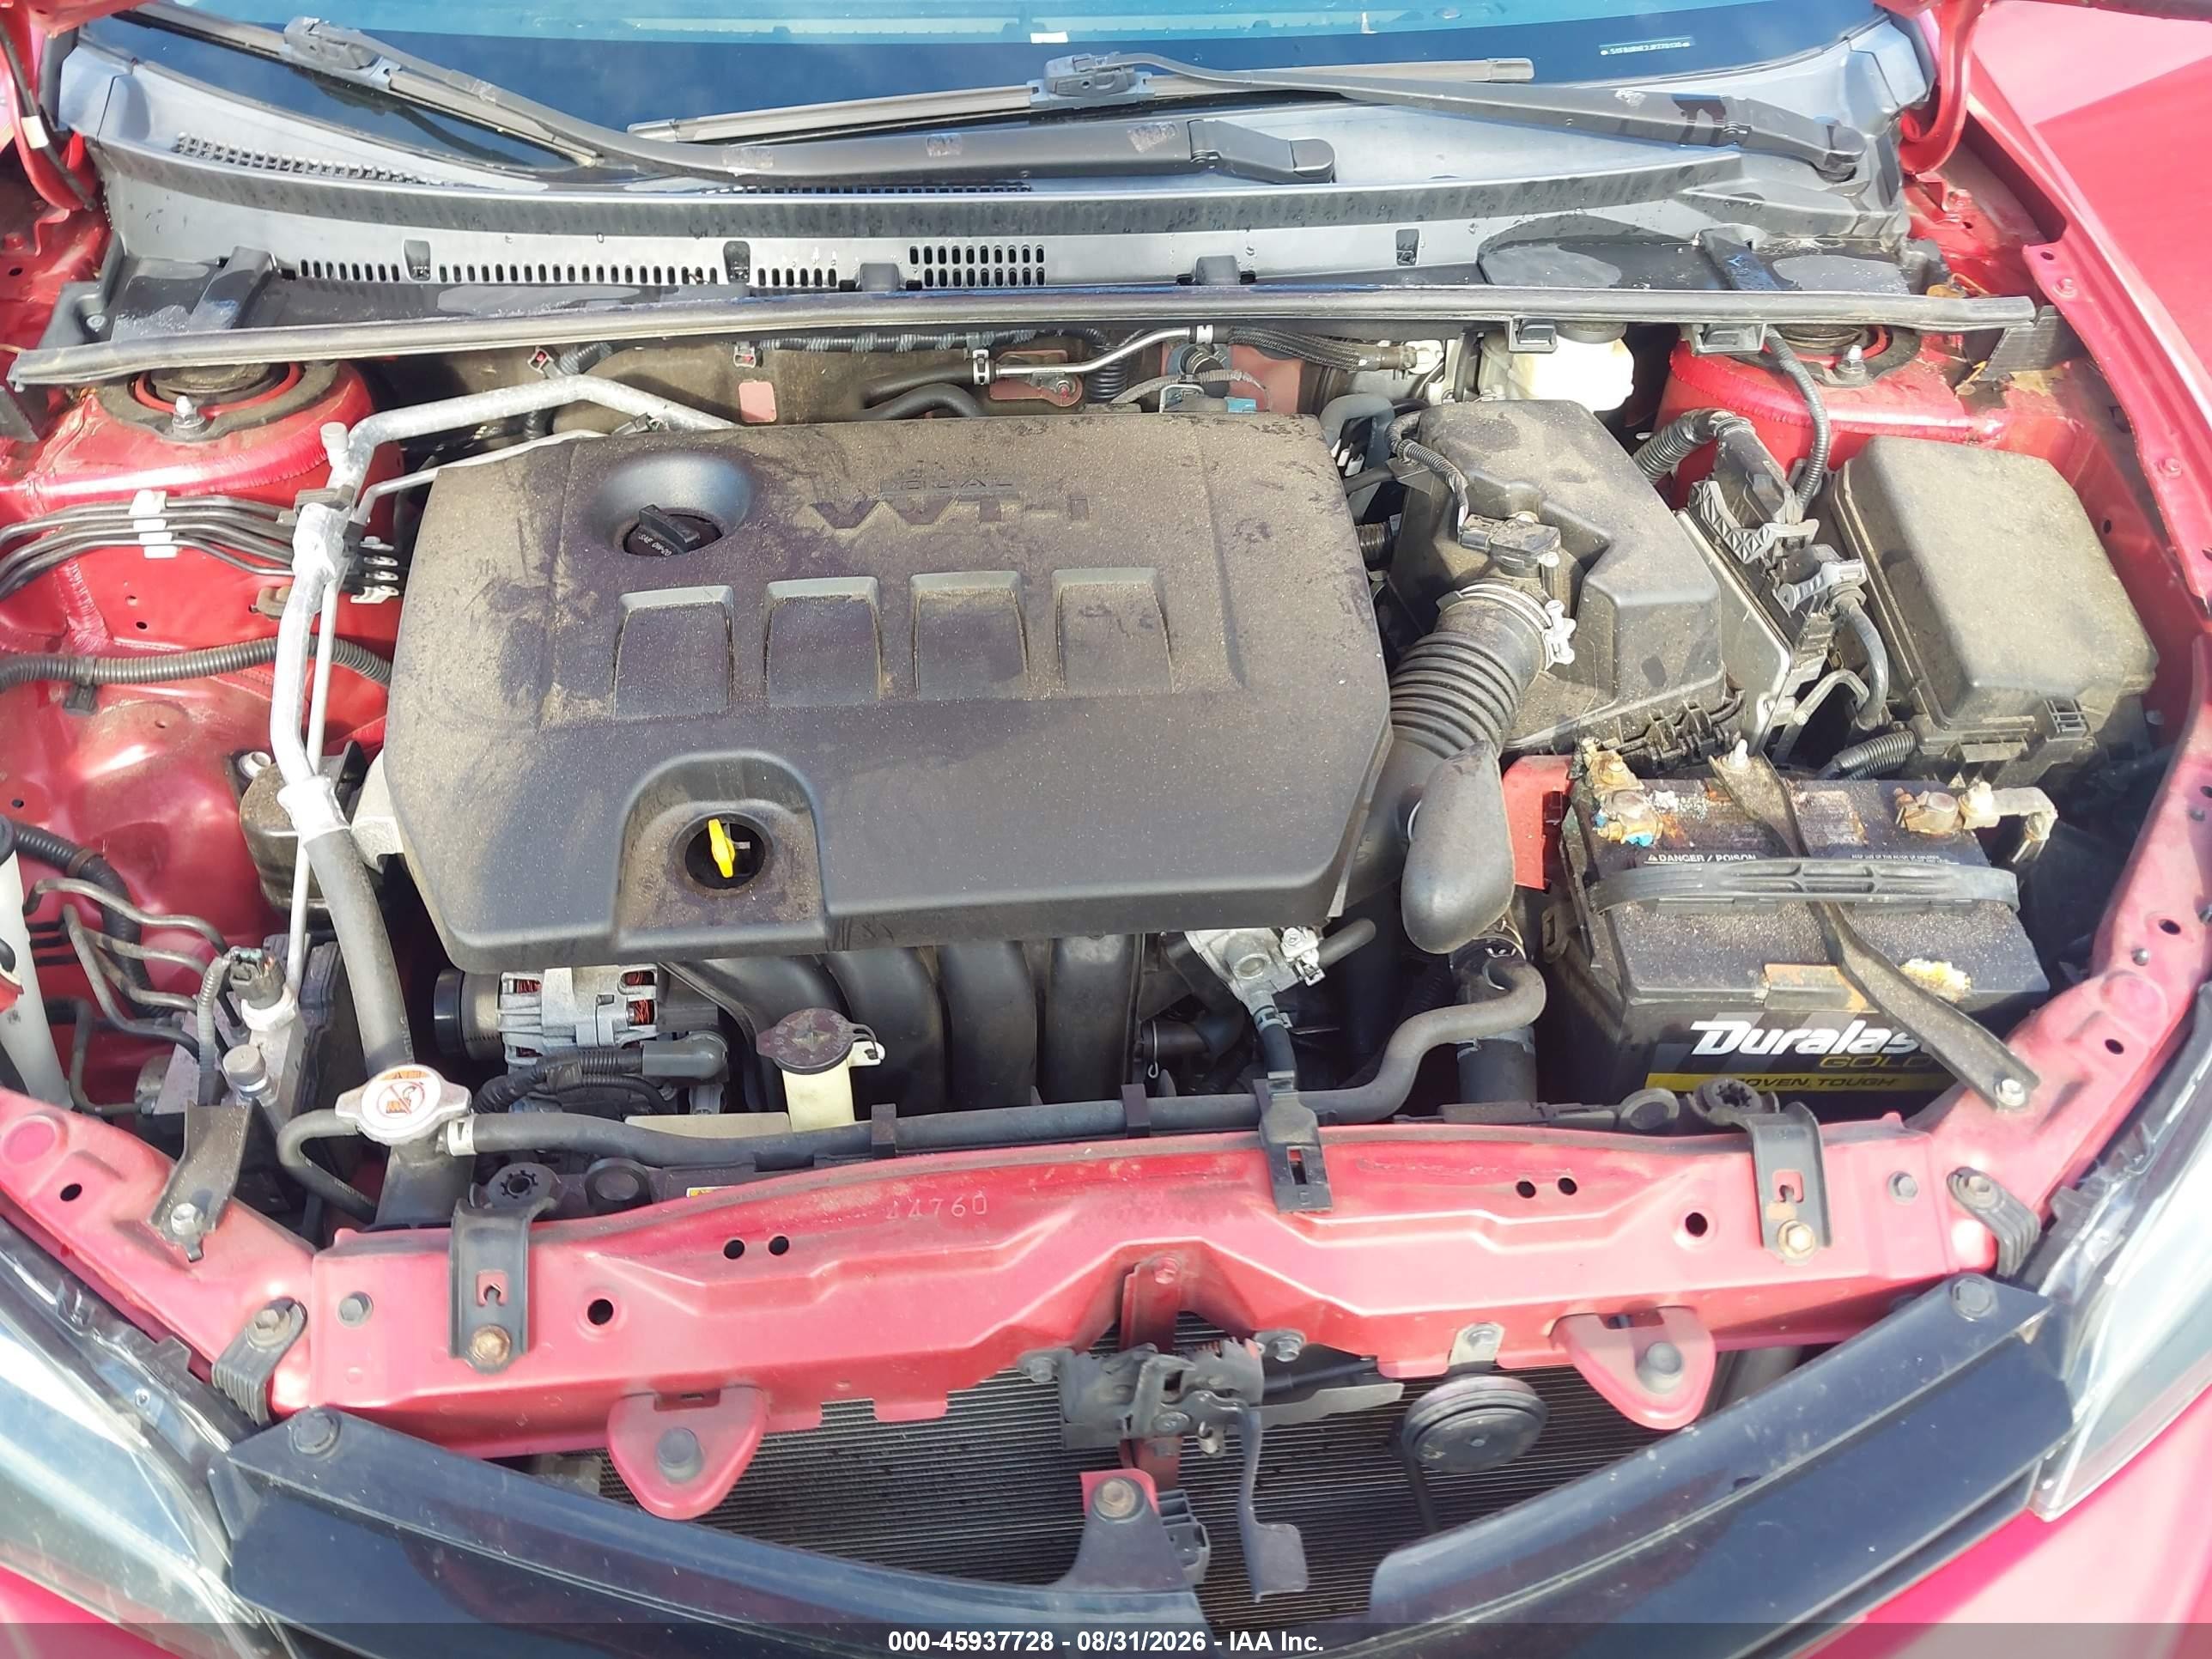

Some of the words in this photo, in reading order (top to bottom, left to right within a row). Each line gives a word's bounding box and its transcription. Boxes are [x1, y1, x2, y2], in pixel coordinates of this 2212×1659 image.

[638, 533, 653, 544] SAE
[1658, 854, 1705, 862] DANGER
[1716, 854, 1757, 862] POISON
[1689, 1019, 1920, 1055] Duralas
[1819, 1055, 1931, 1068] GOLD
[1736, 1078, 1810, 1087] OVEN
[1817, 1078, 1898, 1087] TOUGH
